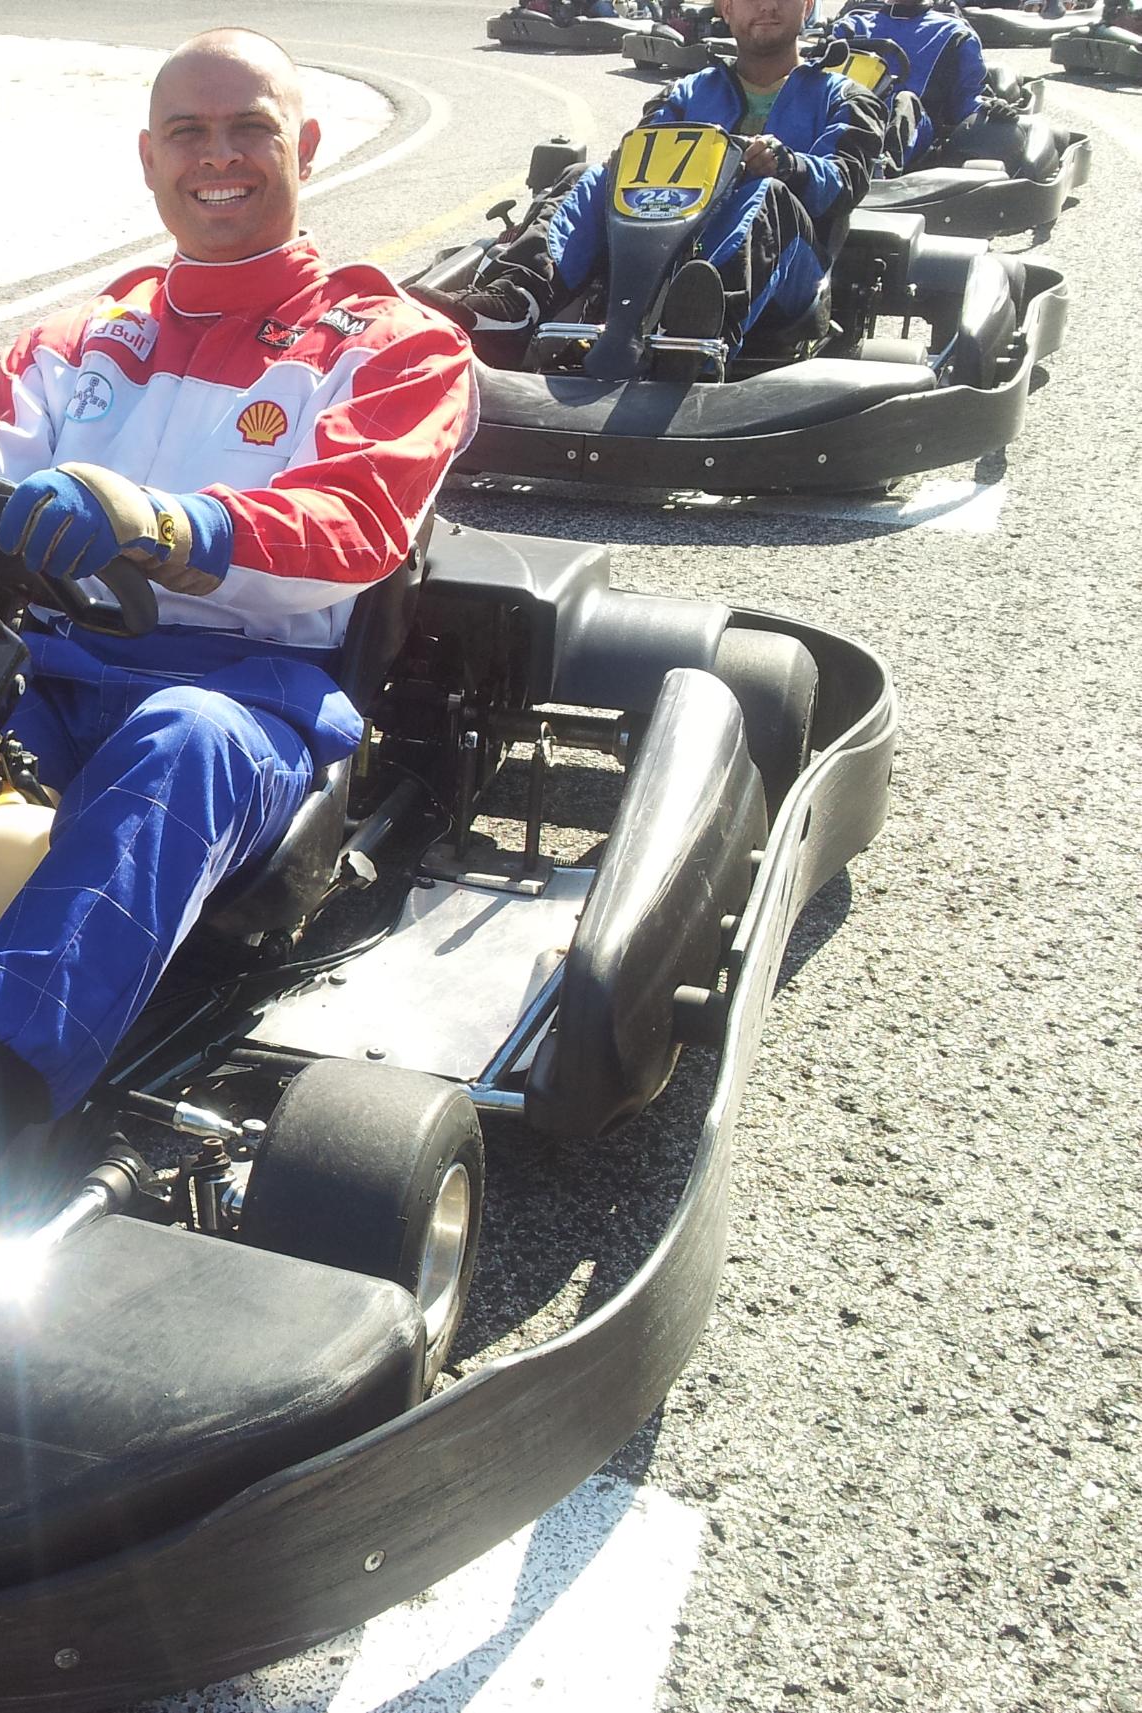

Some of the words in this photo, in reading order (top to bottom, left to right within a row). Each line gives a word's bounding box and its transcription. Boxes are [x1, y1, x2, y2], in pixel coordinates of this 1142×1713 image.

[629, 130, 703, 184] 17
[641, 190, 671, 203] 24
[110, 324, 146, 352] Bull
